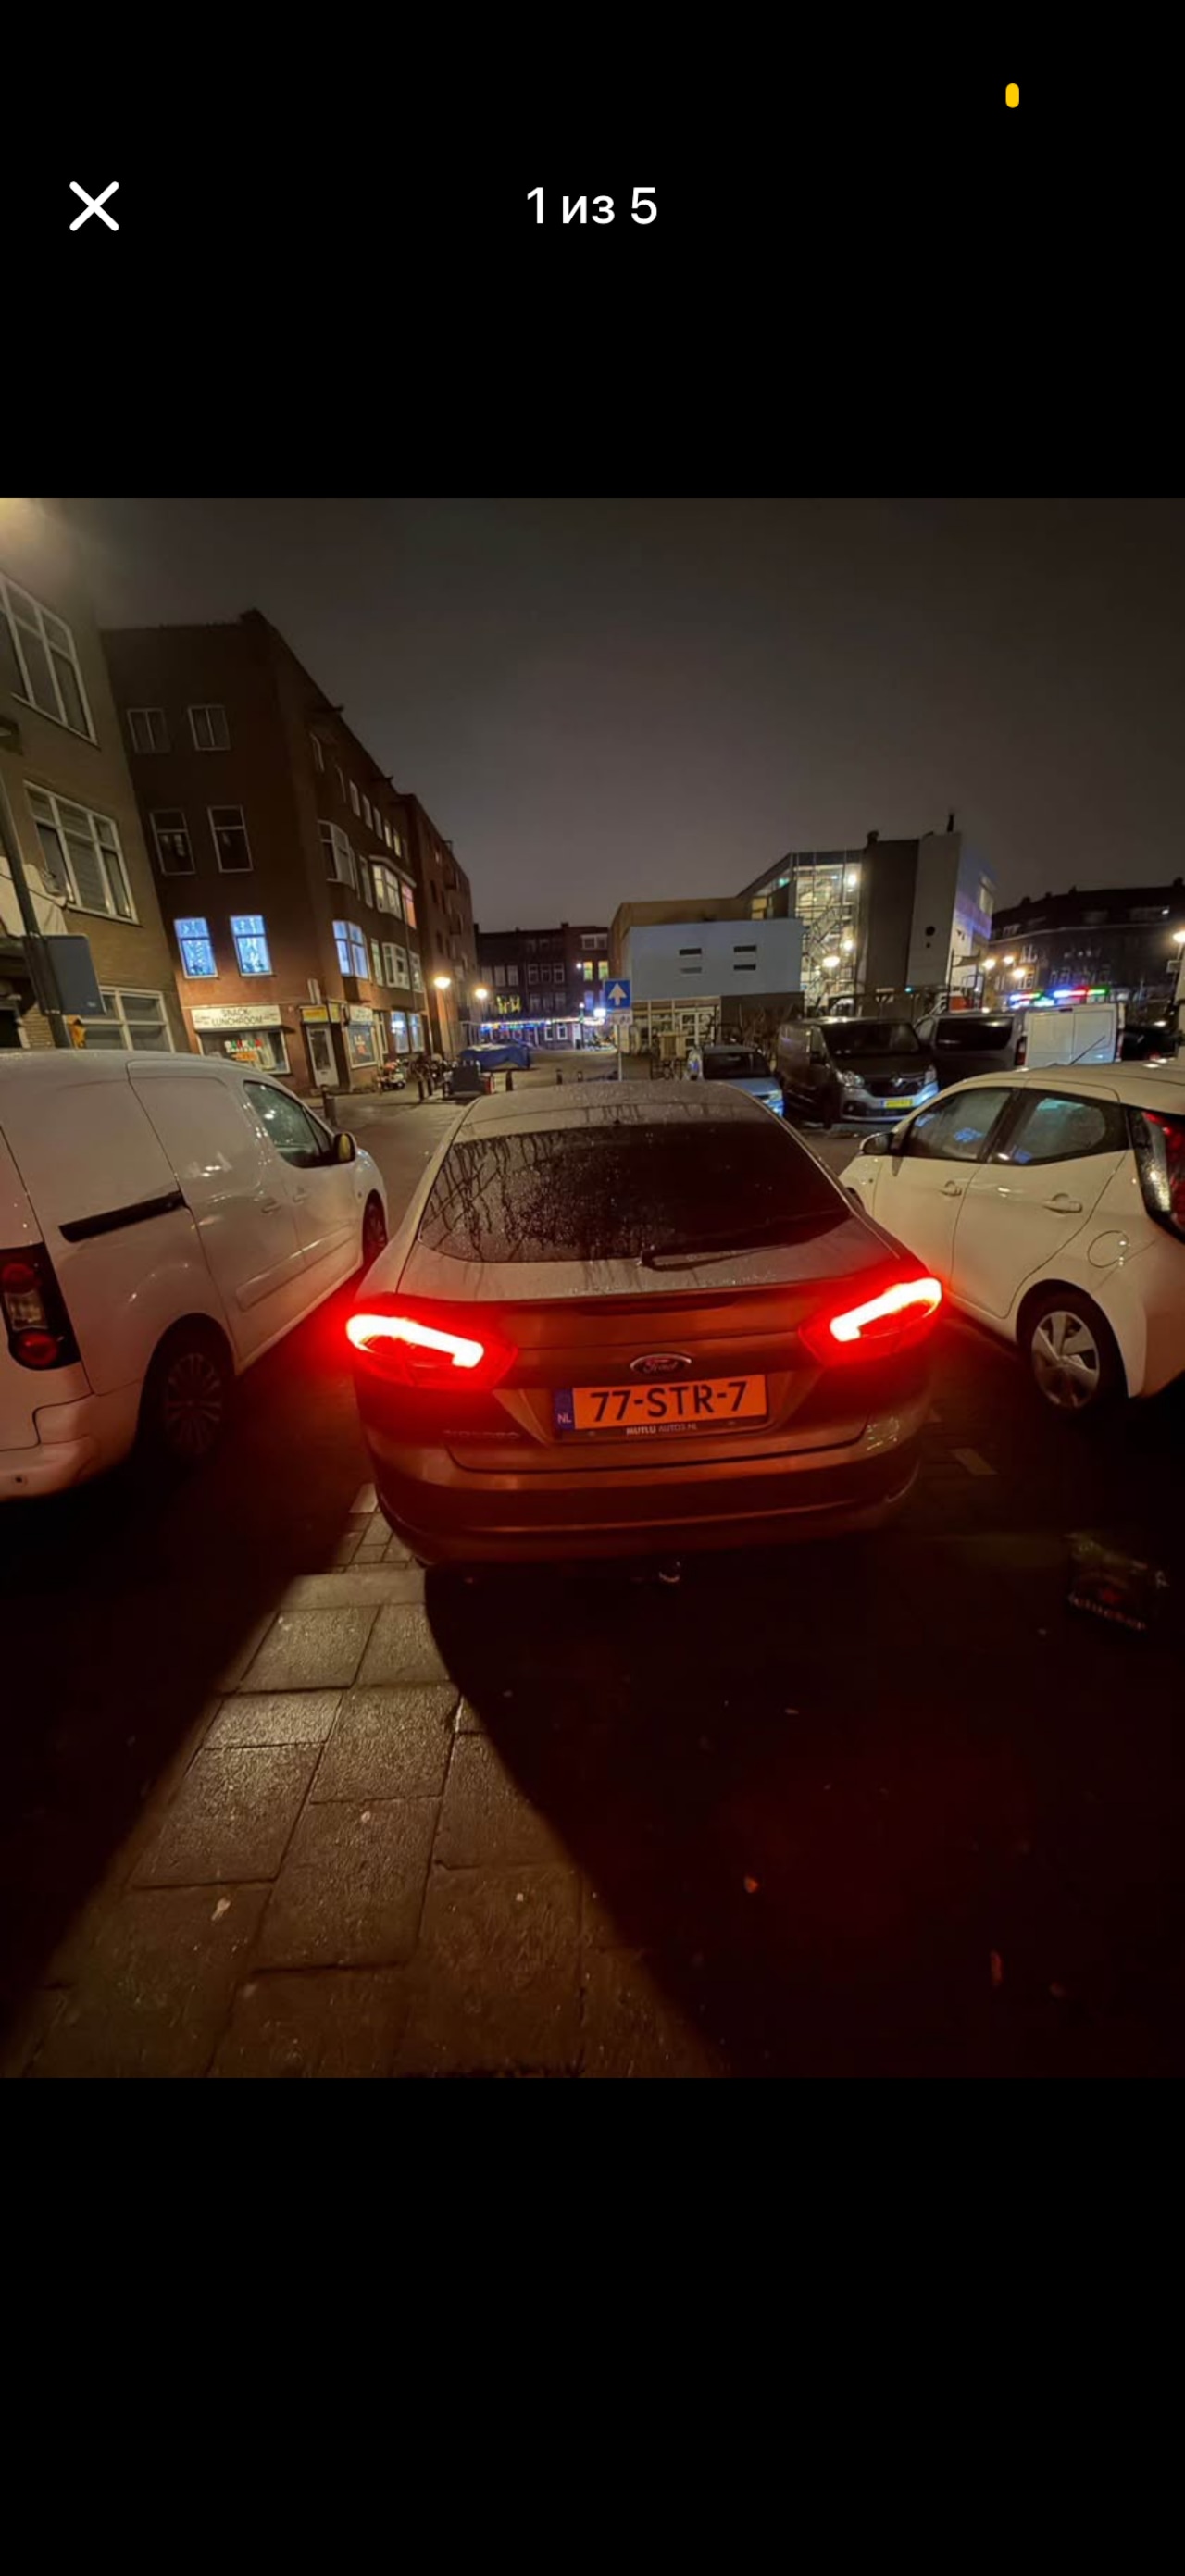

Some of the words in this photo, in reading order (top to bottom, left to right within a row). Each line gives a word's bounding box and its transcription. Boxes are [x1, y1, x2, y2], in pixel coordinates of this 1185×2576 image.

[211, 1015, 262, 1027] LUNCHROOM
[642, 1360, 677, 1374] Ford
[590, 1381, 747, 1422] 77-STR-7
[557, 1413, 571, 1424] NL
[626, 1425, 656, 1435] MUTLU
